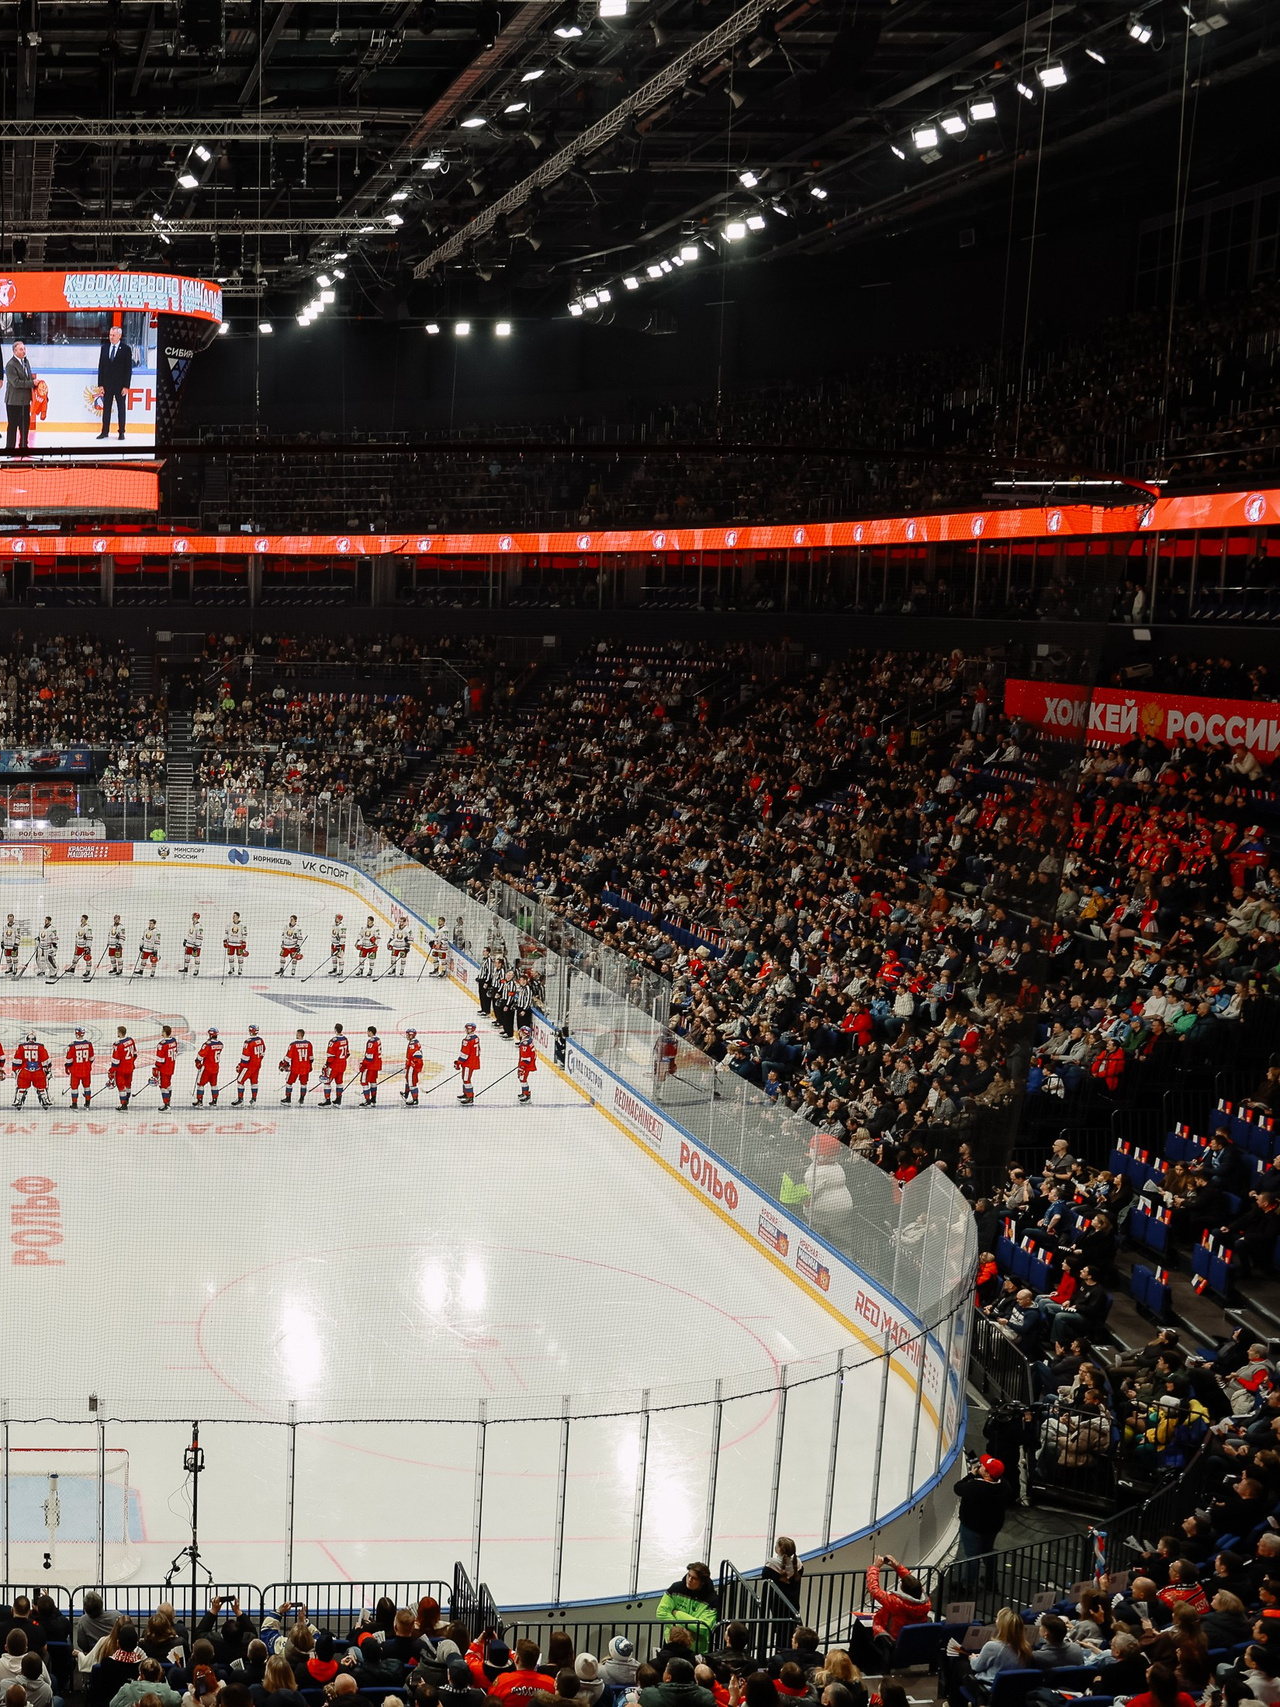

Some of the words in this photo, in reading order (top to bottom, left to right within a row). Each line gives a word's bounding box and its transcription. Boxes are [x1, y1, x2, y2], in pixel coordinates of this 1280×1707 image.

[63, 274, 120, 298] КУБОК
[120, 274, 180, 302] ПЕРВОГО
[1042, 697, 1138, 734] ХОККЕЙ
[253, 856, 292, 866] НОРНИКЕЛЬ
[301, 860, 317, 872] VK
[319, 864, 350, 881] СПОРТ
[75, 1050, 90, 1064] 89
[254, 1044, 264, 1059] 44
[297, 1049, 308, 1062] 14
[679, 1141, 739, 1210] РОЛЬФ
[10, 1176, 66, 1266] РОЛЬФ
[854, 1290, 880, 1328] RED
